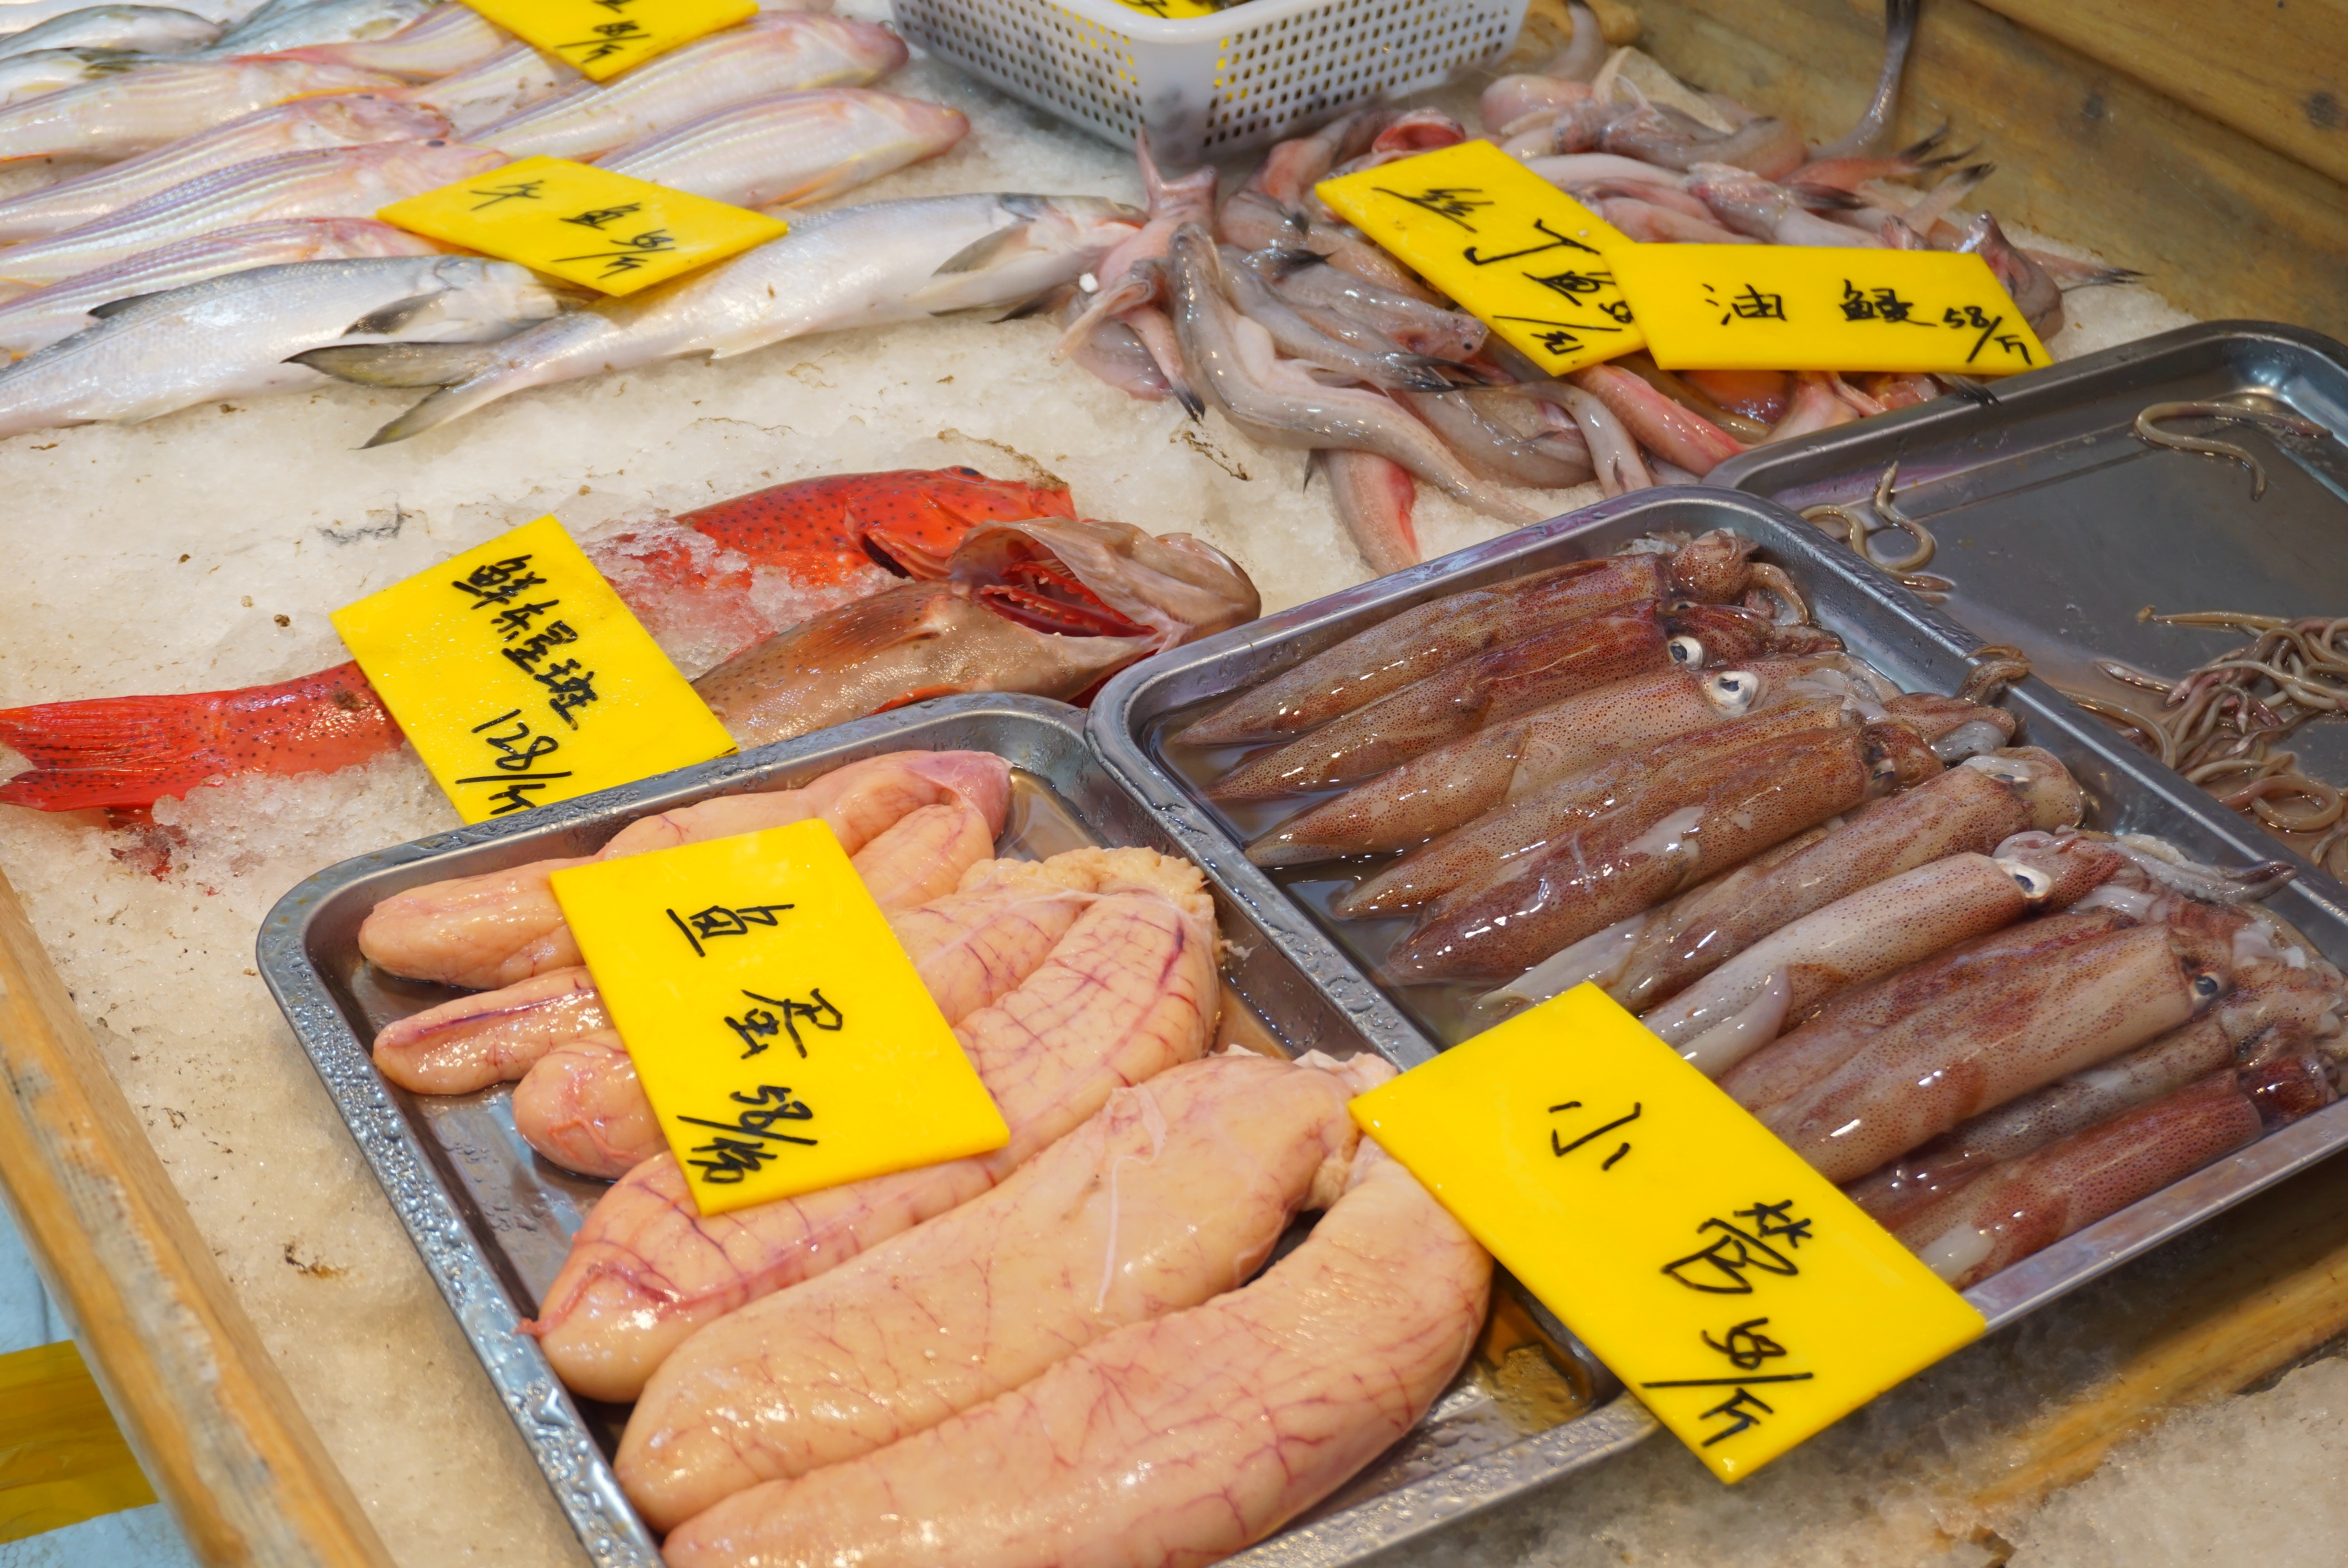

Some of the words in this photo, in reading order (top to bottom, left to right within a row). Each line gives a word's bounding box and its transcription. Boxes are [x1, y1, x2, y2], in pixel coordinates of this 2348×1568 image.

[1943, 306, 2032, 365] 58/斤
[451, 554, 598, 731] 鲜东星斑
[1641, 1318, 1814, 1448] 58/斤
